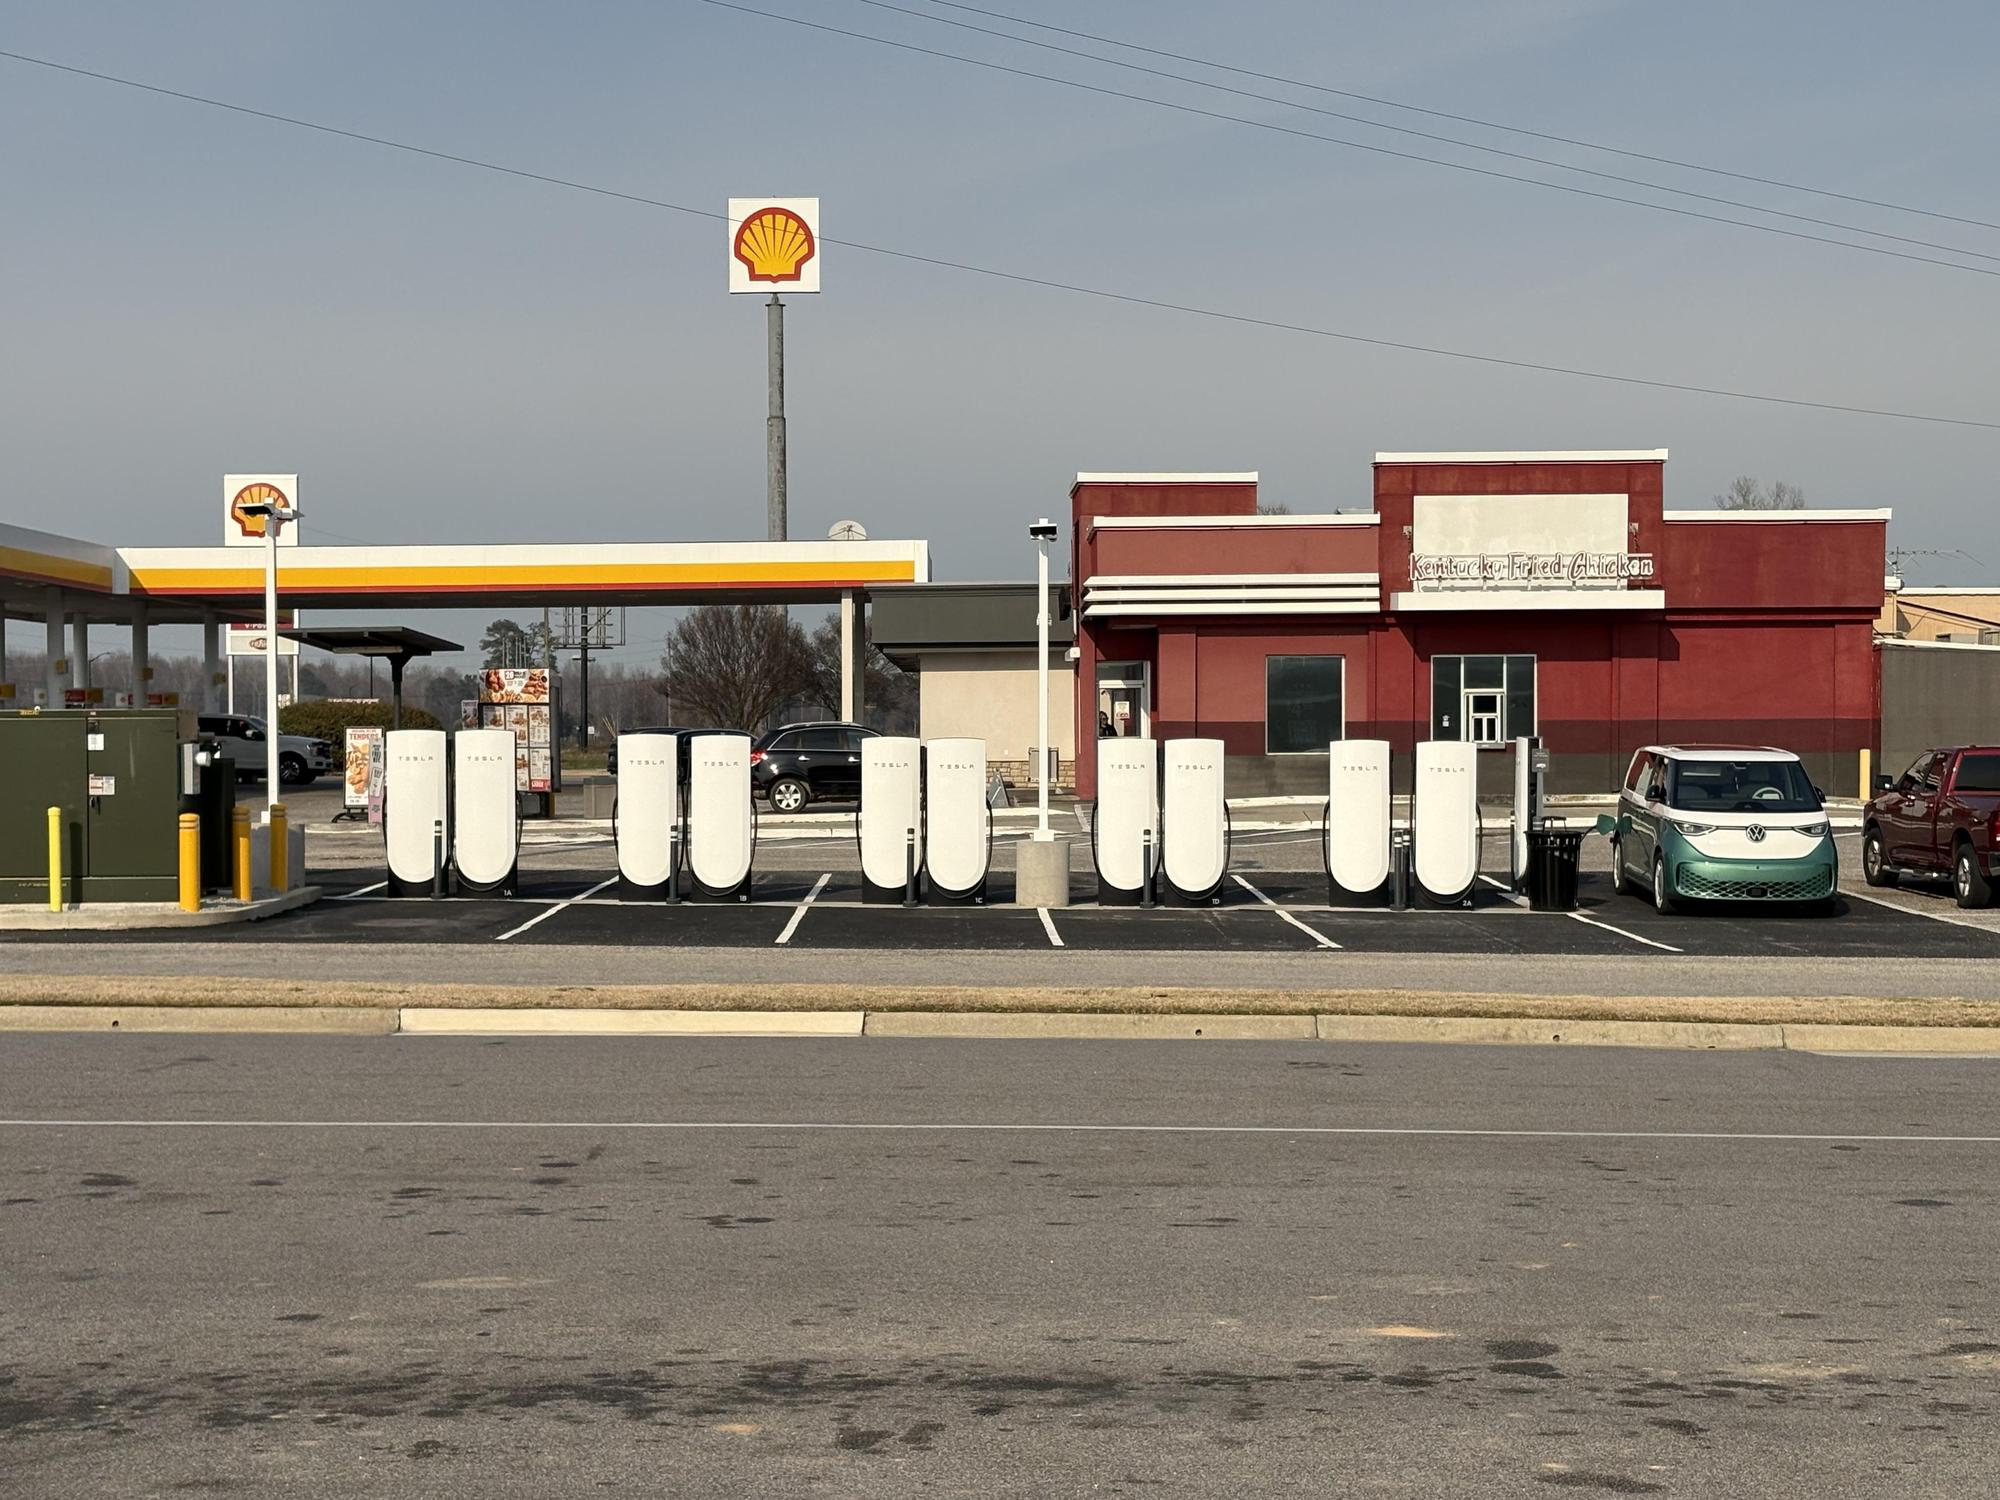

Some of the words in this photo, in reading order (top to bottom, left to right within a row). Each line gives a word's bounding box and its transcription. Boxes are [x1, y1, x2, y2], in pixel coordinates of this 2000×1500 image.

[1410, 553, 1503, 580] Kentucky
[1508, 552, 1563, 580] Fried
[1567, 552, 1653, 581] Chicken
